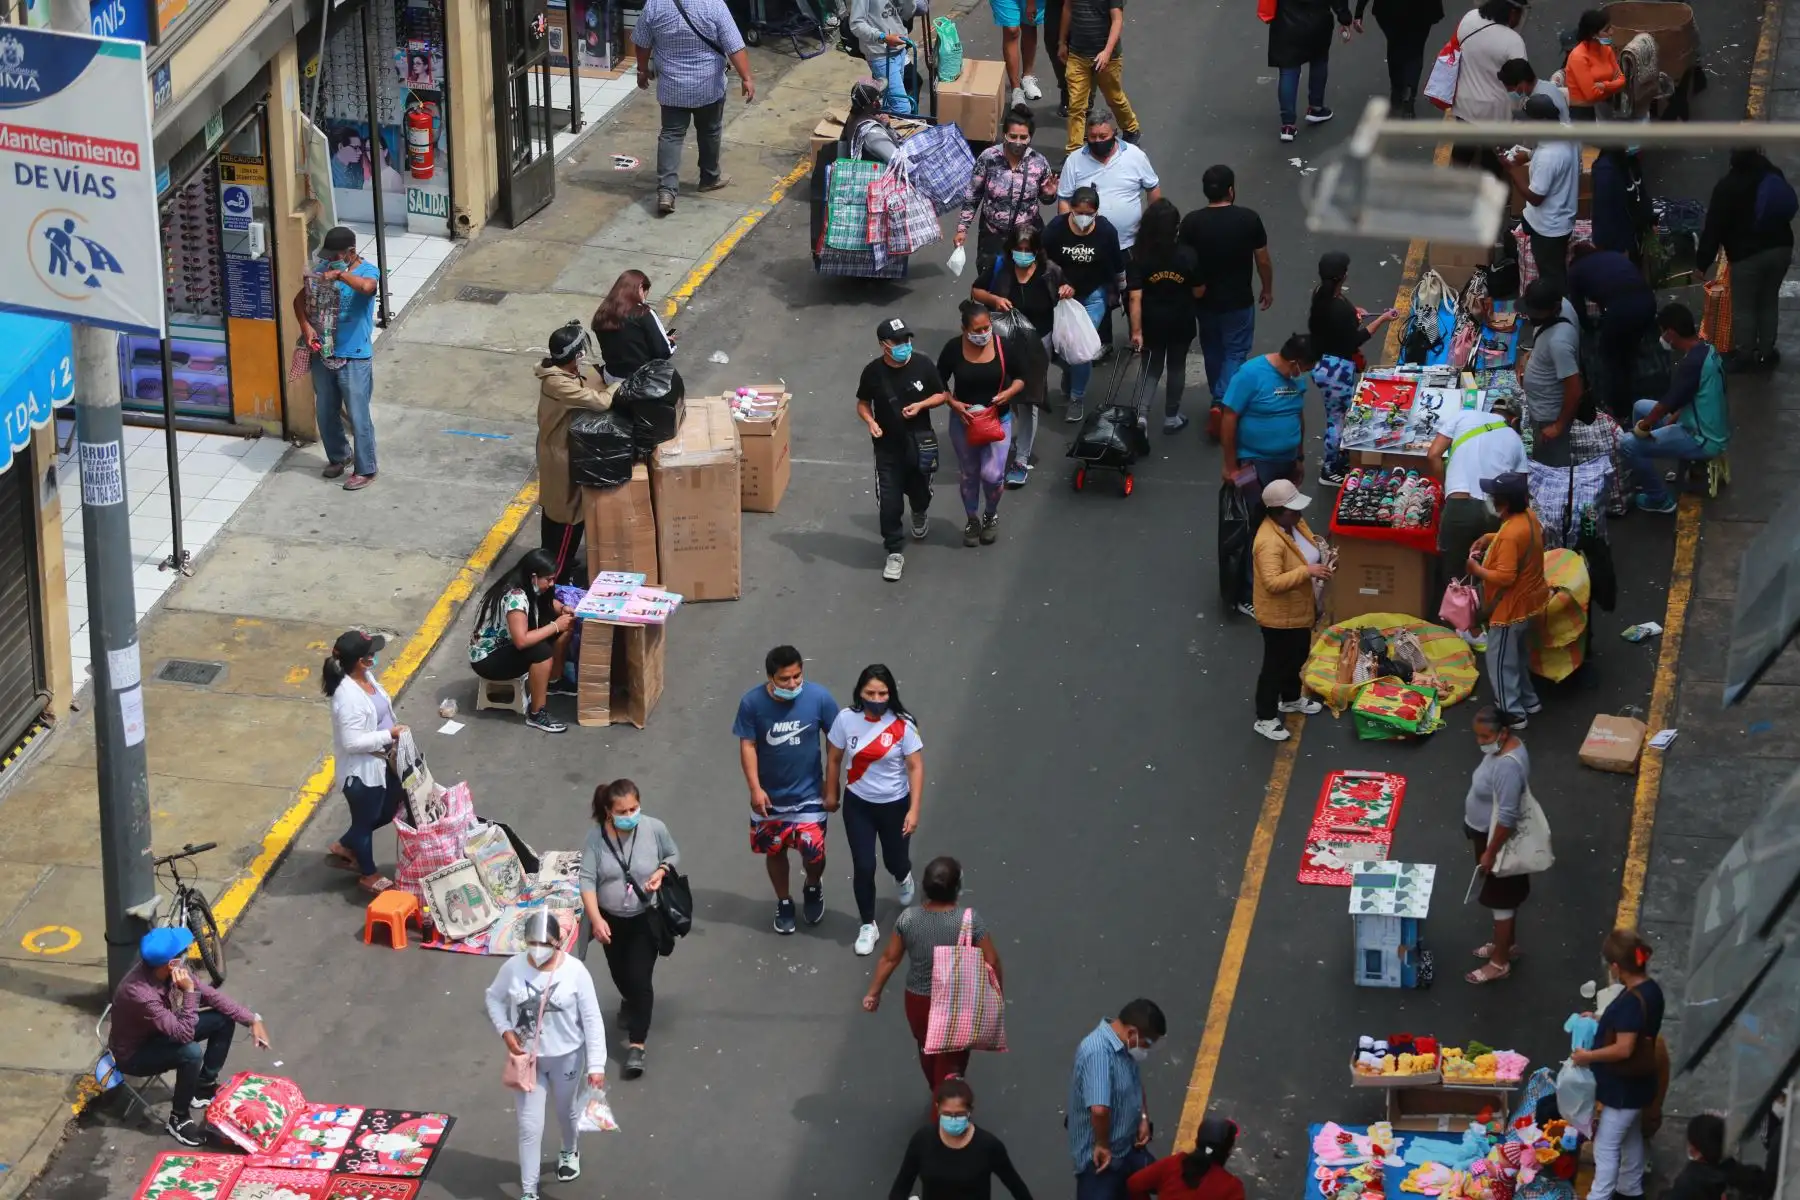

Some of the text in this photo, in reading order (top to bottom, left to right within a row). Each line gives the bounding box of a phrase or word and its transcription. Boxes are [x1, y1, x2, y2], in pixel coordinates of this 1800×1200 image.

[154, 80, 171, 110] 922
[14, 162, 117, 200] DE VÍAS
[409, 189, 447, 216] SALIDA
[1062, 246, 1095, 255] THANK
[1071, 255, 1092, 263] YOU
[50, 356, 72, 394] 12
[82, 443, 118, 460] BRUJO
[84, 469, 120, 486] AMARRES
[772, 720, 801, 733] NIKE
[788, 736, 801, 746] SB
[850, 736, 858, 750] 9
[372, 1117, 388, 1133] HO
